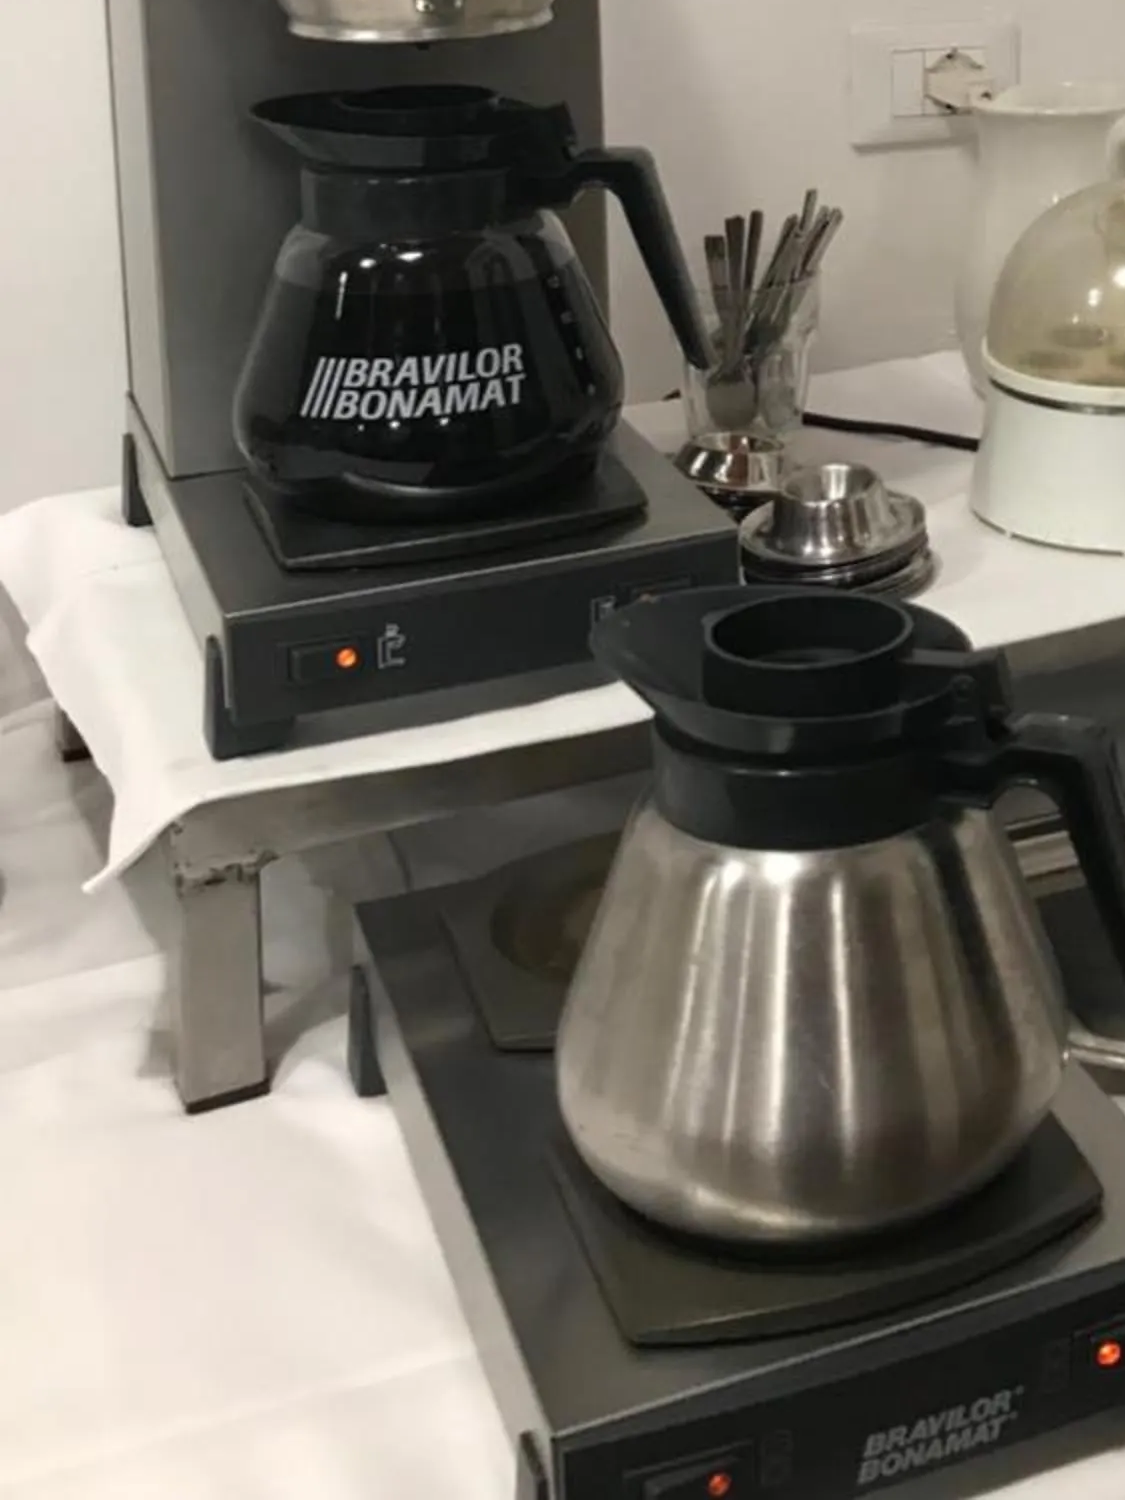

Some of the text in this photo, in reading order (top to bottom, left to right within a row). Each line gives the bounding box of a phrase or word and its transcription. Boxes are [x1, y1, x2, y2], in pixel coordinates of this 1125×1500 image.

[343, 343, 524, 389] BRAVILOR
[333, 373, 526, 420] BONAMAT
[857, 1414, 1008, 1485] BONAMAT
[863, 1389, 1012, 1460] BRAVILOR
